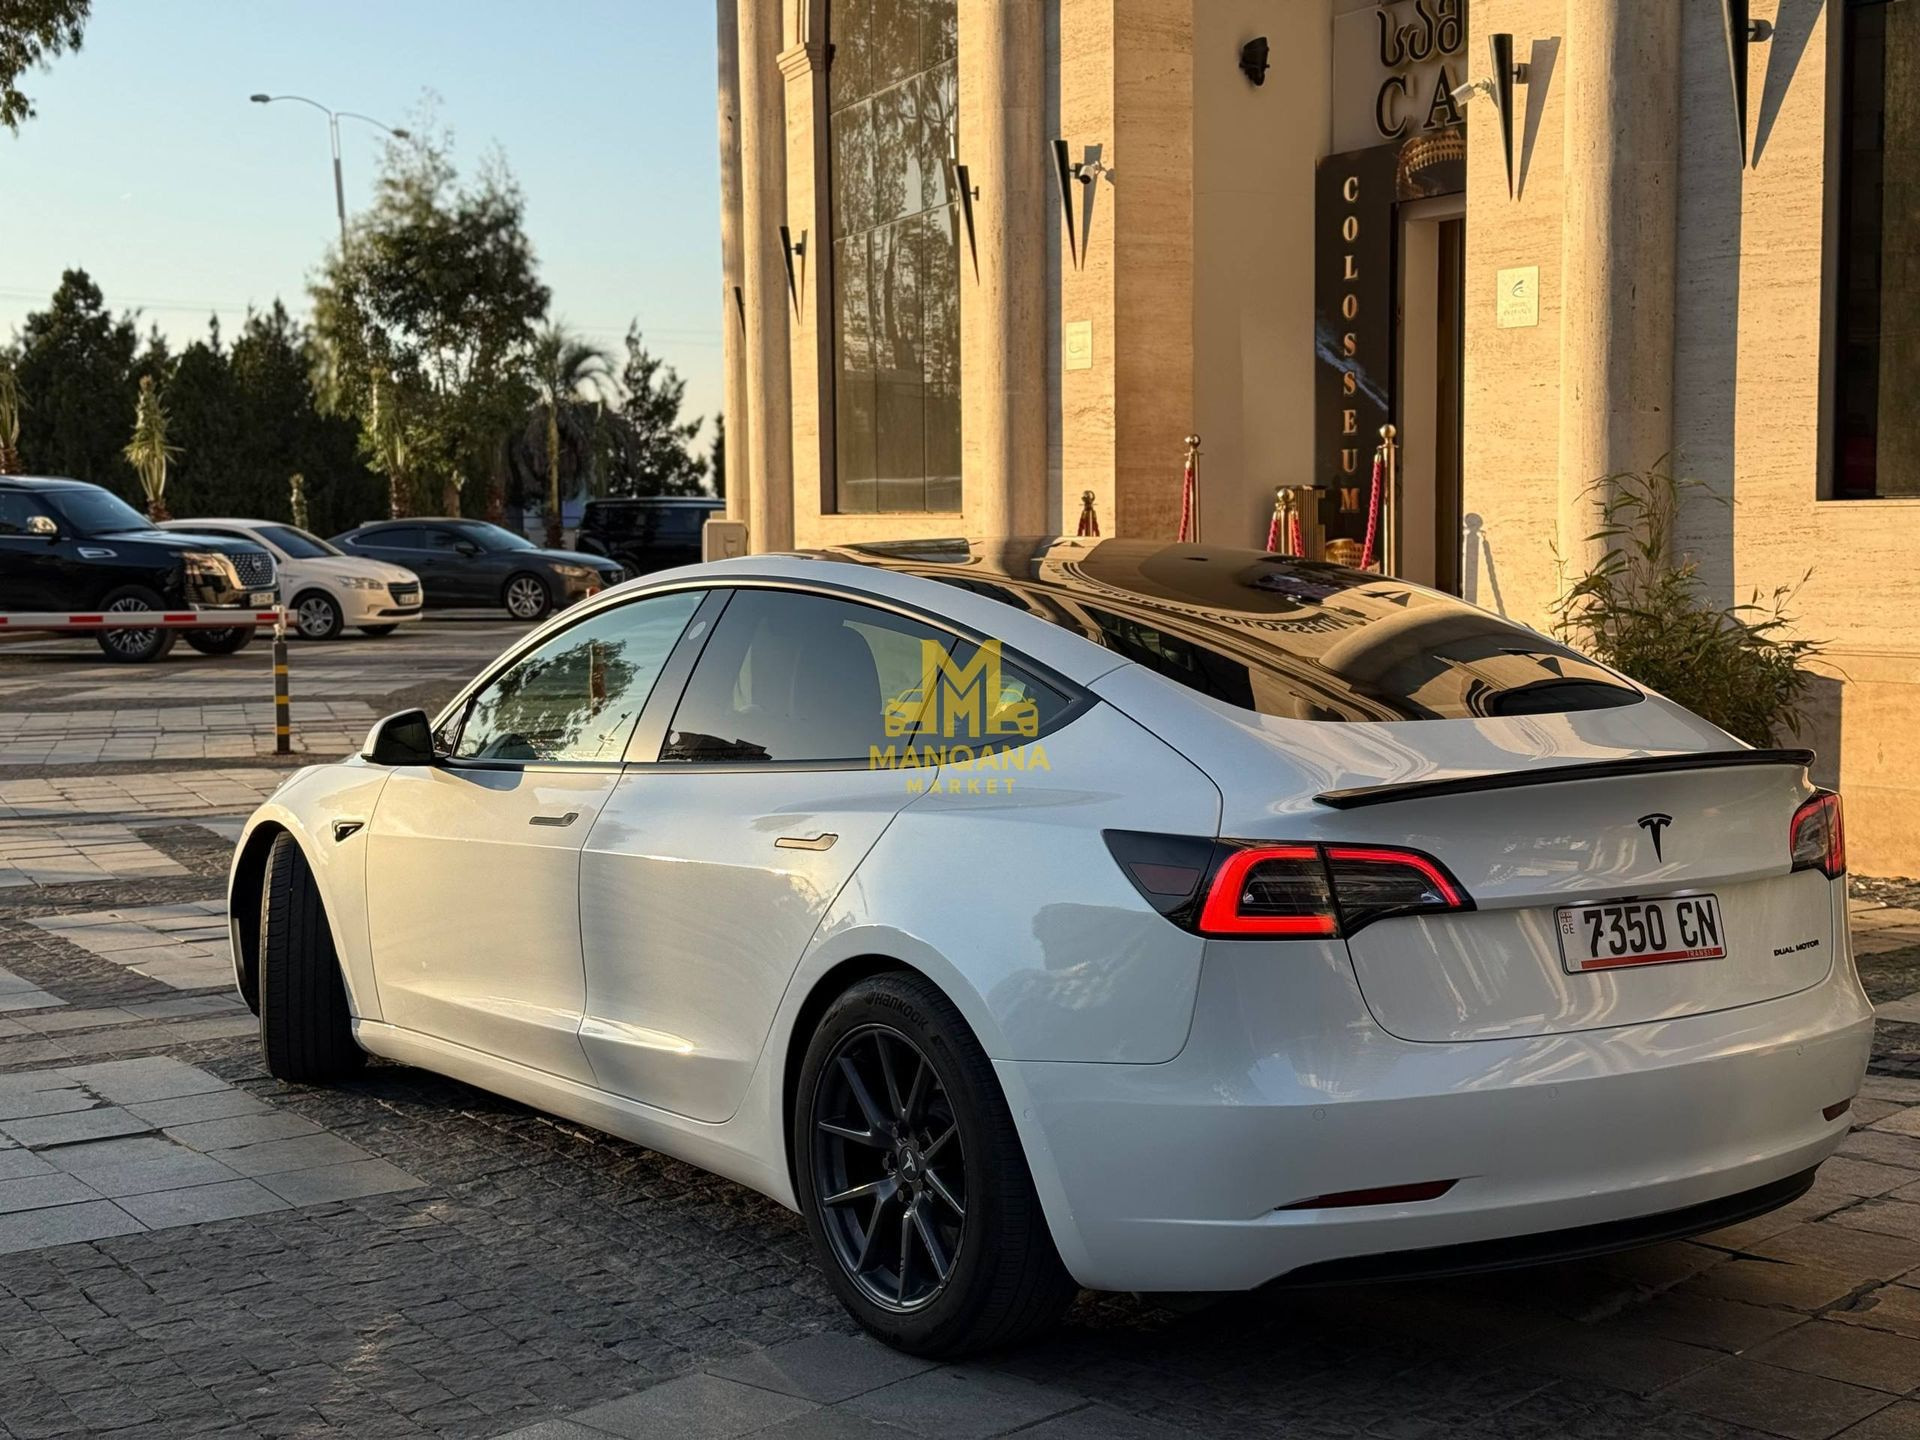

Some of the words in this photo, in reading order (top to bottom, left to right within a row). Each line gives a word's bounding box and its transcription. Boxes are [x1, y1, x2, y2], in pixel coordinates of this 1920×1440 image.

[1340, 176, 1360, 513] COLOSSEUM
[1562, 923, 1575, 934] GE
[1584, 905, 1667, 957] 7350
[1677, 900, 1719, 947] CN
[1773, 946, 1796, 957] DUAL
[1795, 939, 1820, 951] MOTOR
